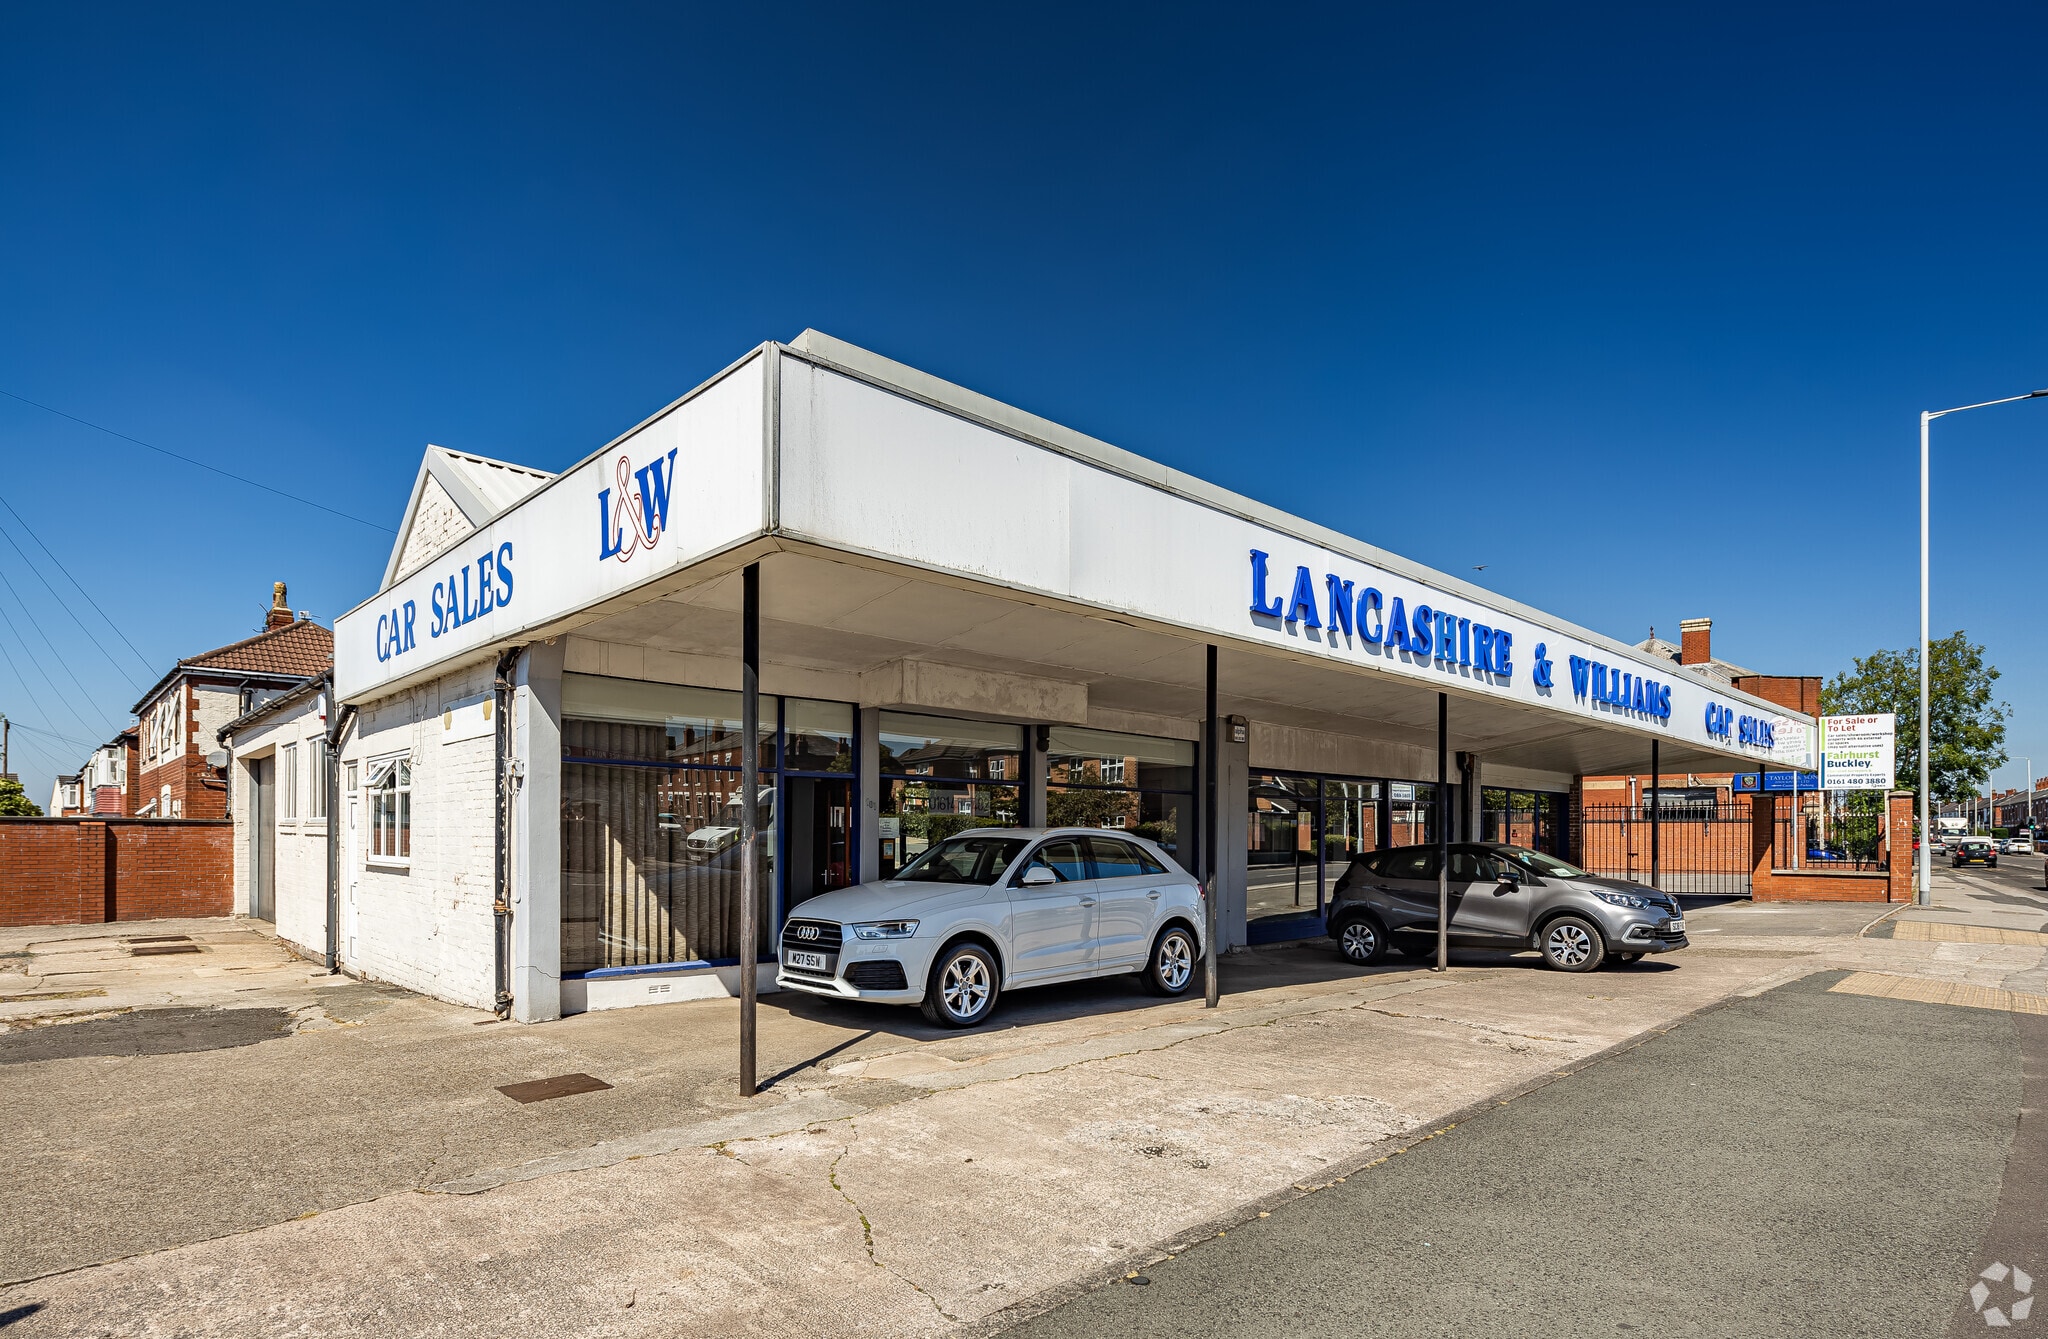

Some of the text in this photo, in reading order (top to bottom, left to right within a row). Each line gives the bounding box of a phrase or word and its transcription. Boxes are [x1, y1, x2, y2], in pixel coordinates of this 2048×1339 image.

[598, 447, 677, 563] L&W
[376, 541, 514, 663] CAR SALES
[1249, 549, 1512, 677] LANCASHIRE
[1533, 642, 1554, 688] &
[1568, 654, 1671, 719] WILLIAMS
[1827, 750, 1880, 759] Fairhurst
[792, 952, 805, 964] M27
